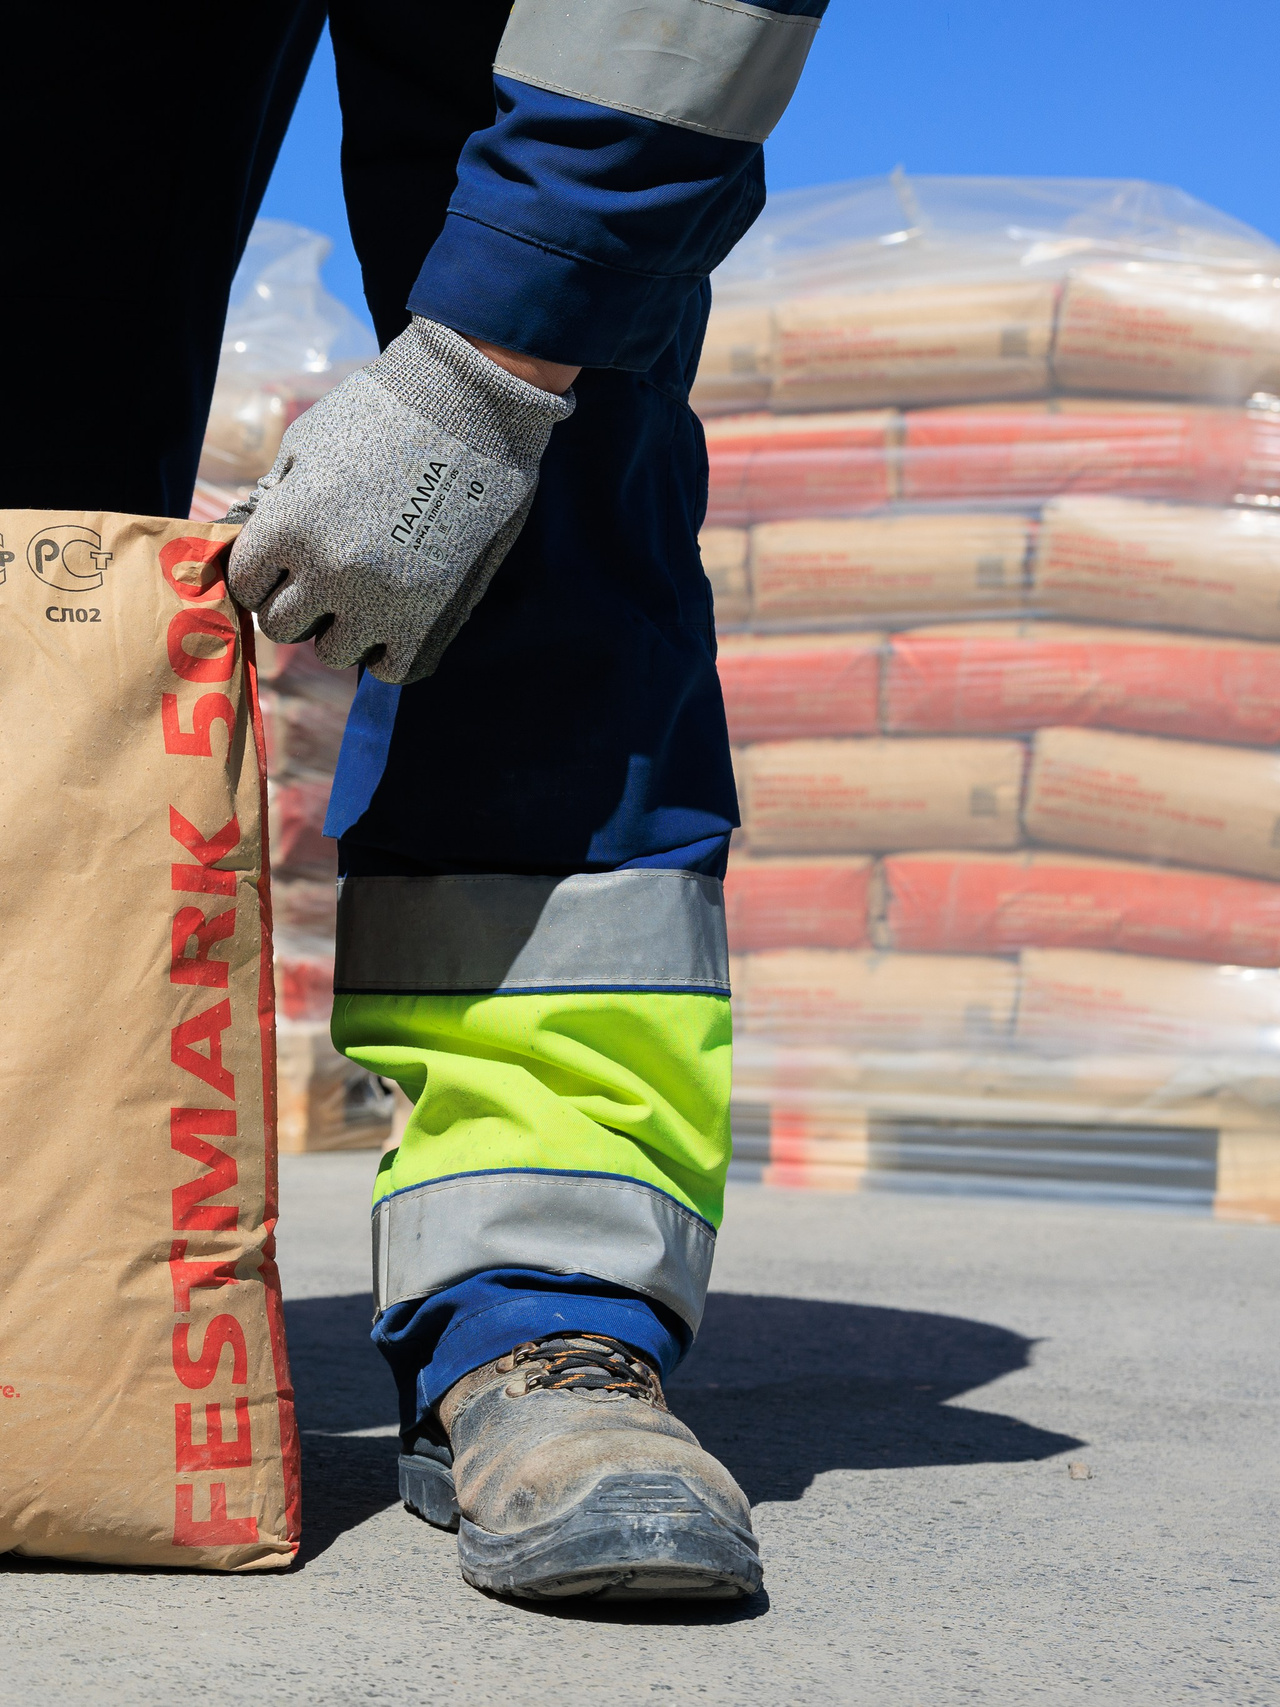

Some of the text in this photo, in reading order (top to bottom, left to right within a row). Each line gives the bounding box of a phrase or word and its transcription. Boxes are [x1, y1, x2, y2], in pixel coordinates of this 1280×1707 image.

[390, 461, 449, 545] ПАЛМА
[467, 480, 485, 502] 10
[413, 525, 431, 552] АРМА
[427, 493, 446, 523] ПЛЮС
[45, 605, 102, 623] СЛ02
[158, 535, 258, 1548] FESTMARK 500
